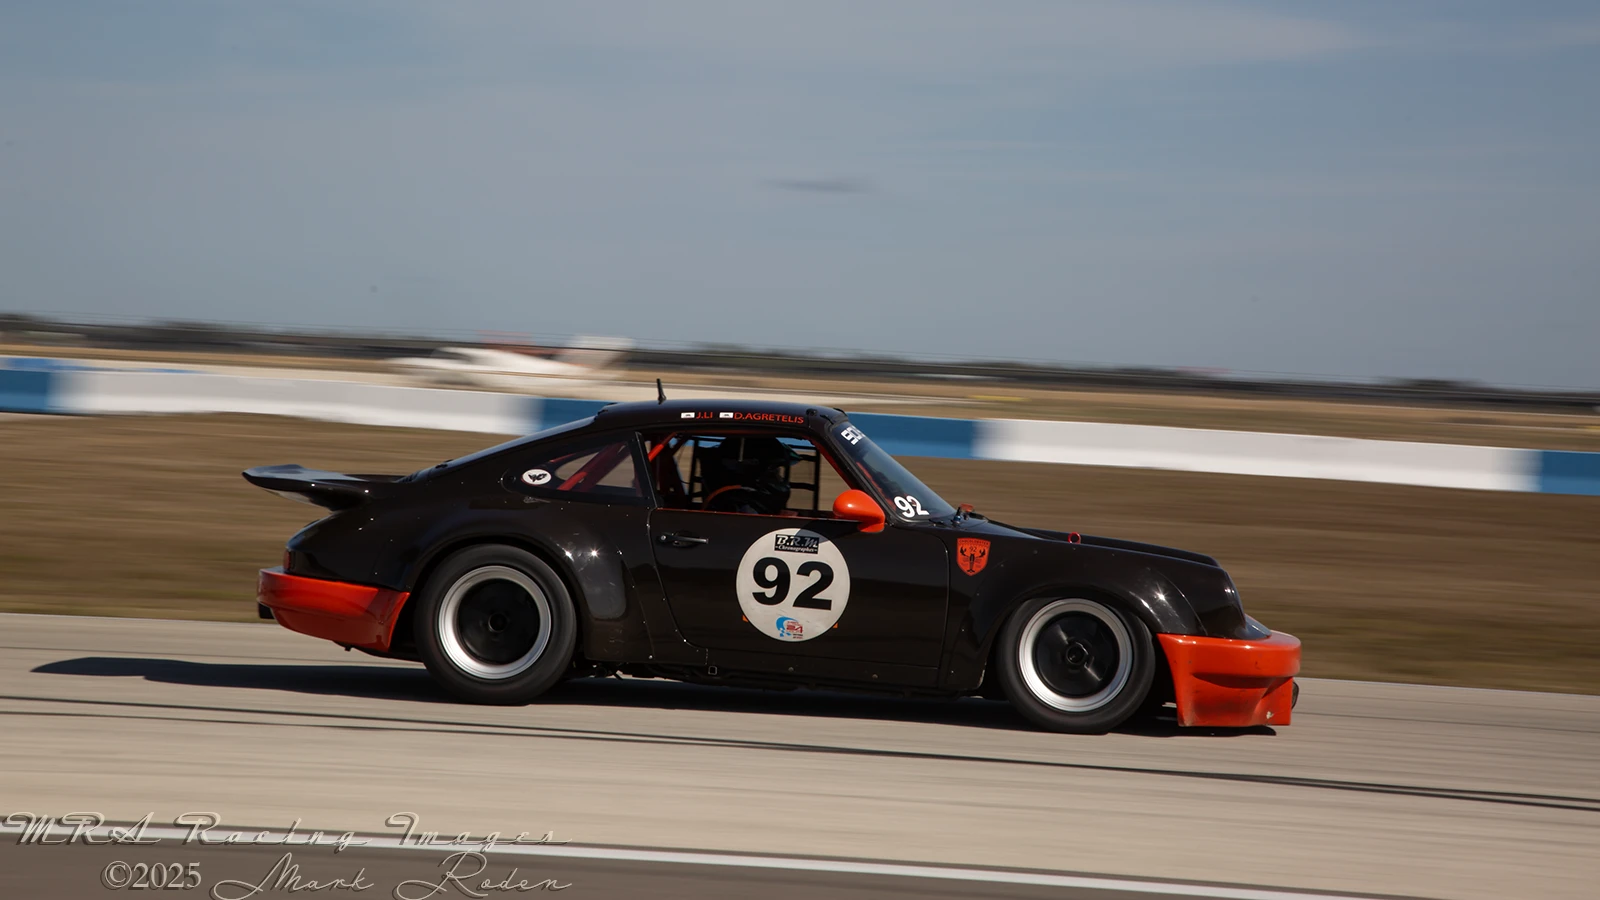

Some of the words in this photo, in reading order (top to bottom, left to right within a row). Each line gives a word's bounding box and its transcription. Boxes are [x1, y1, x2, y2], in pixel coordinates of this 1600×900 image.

[734, 412, 804, 424] D.AGRETELIS
[893, 495, 930, 518] 92
[752, 556, 834, 611] 92
